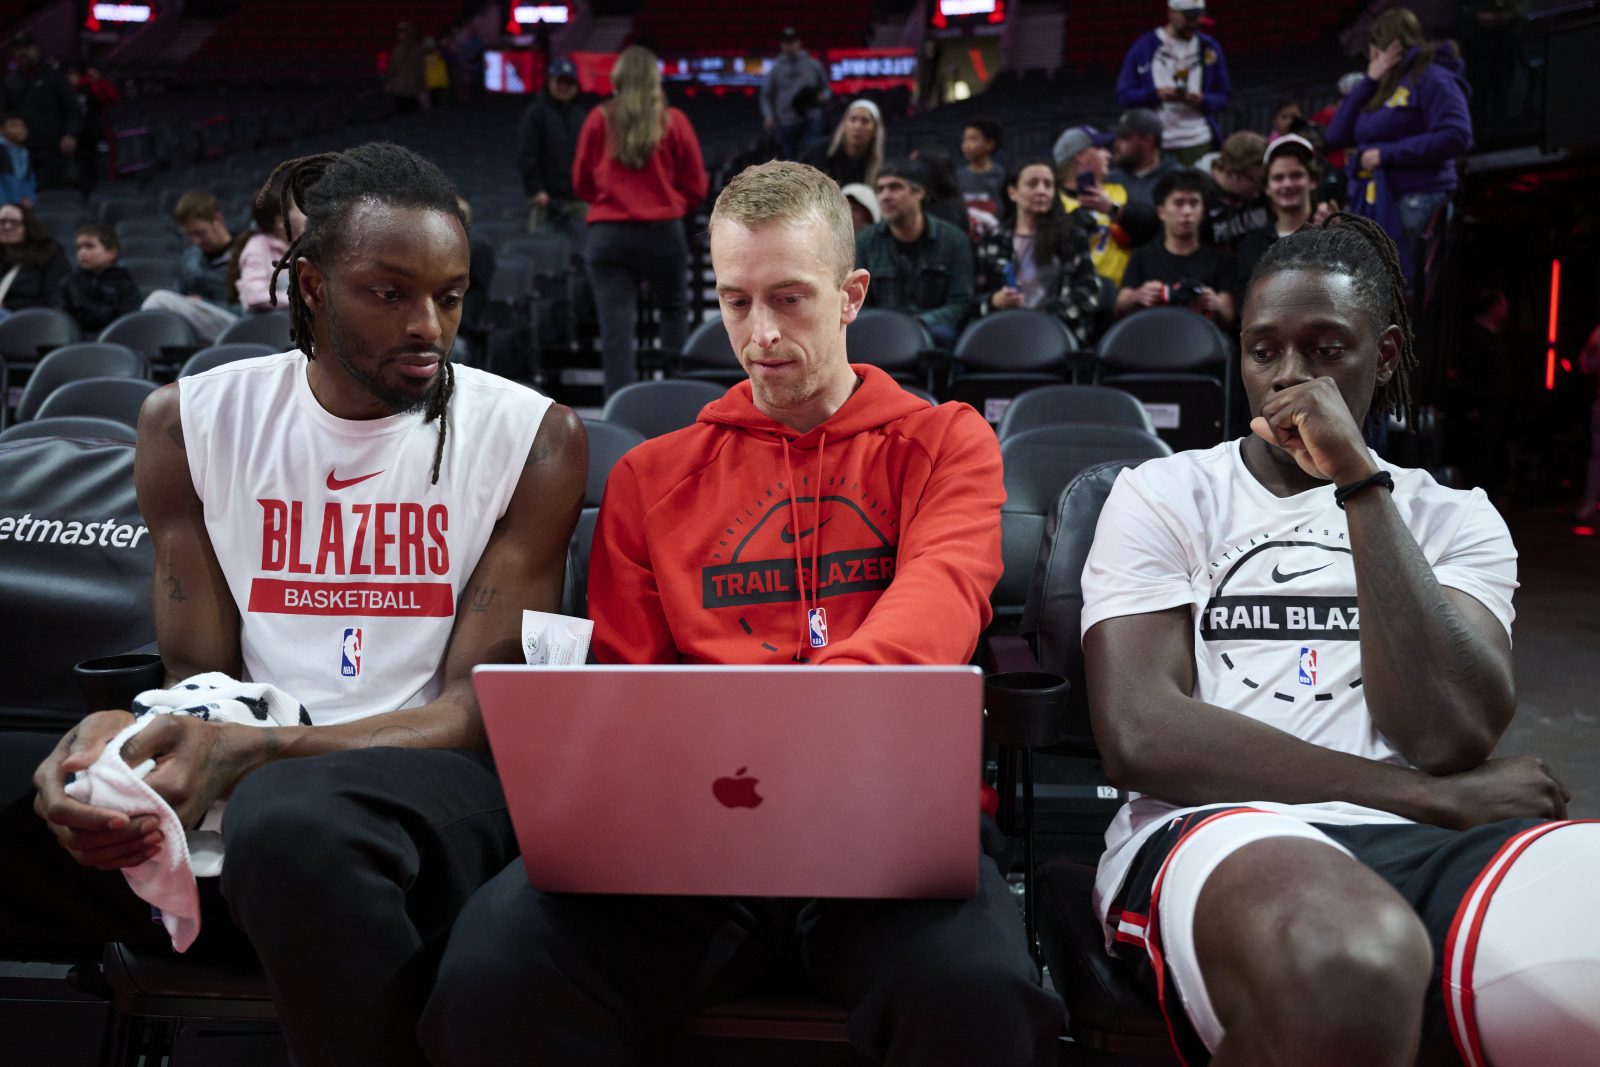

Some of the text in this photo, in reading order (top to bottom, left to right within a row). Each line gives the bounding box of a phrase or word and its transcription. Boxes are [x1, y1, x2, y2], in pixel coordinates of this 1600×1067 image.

[0, 513, 149, 548] etmaster
[256, 498, 450, 576] BLAZERS
[711, 569, 789, 598] TRAIL
[284, 588, 421, 609] BASKETBALL
[1285, 606, 1360, 630] BLAZ
[342, 665, 354, 675] NBA
[1101, 787, 1113, 797] 12
